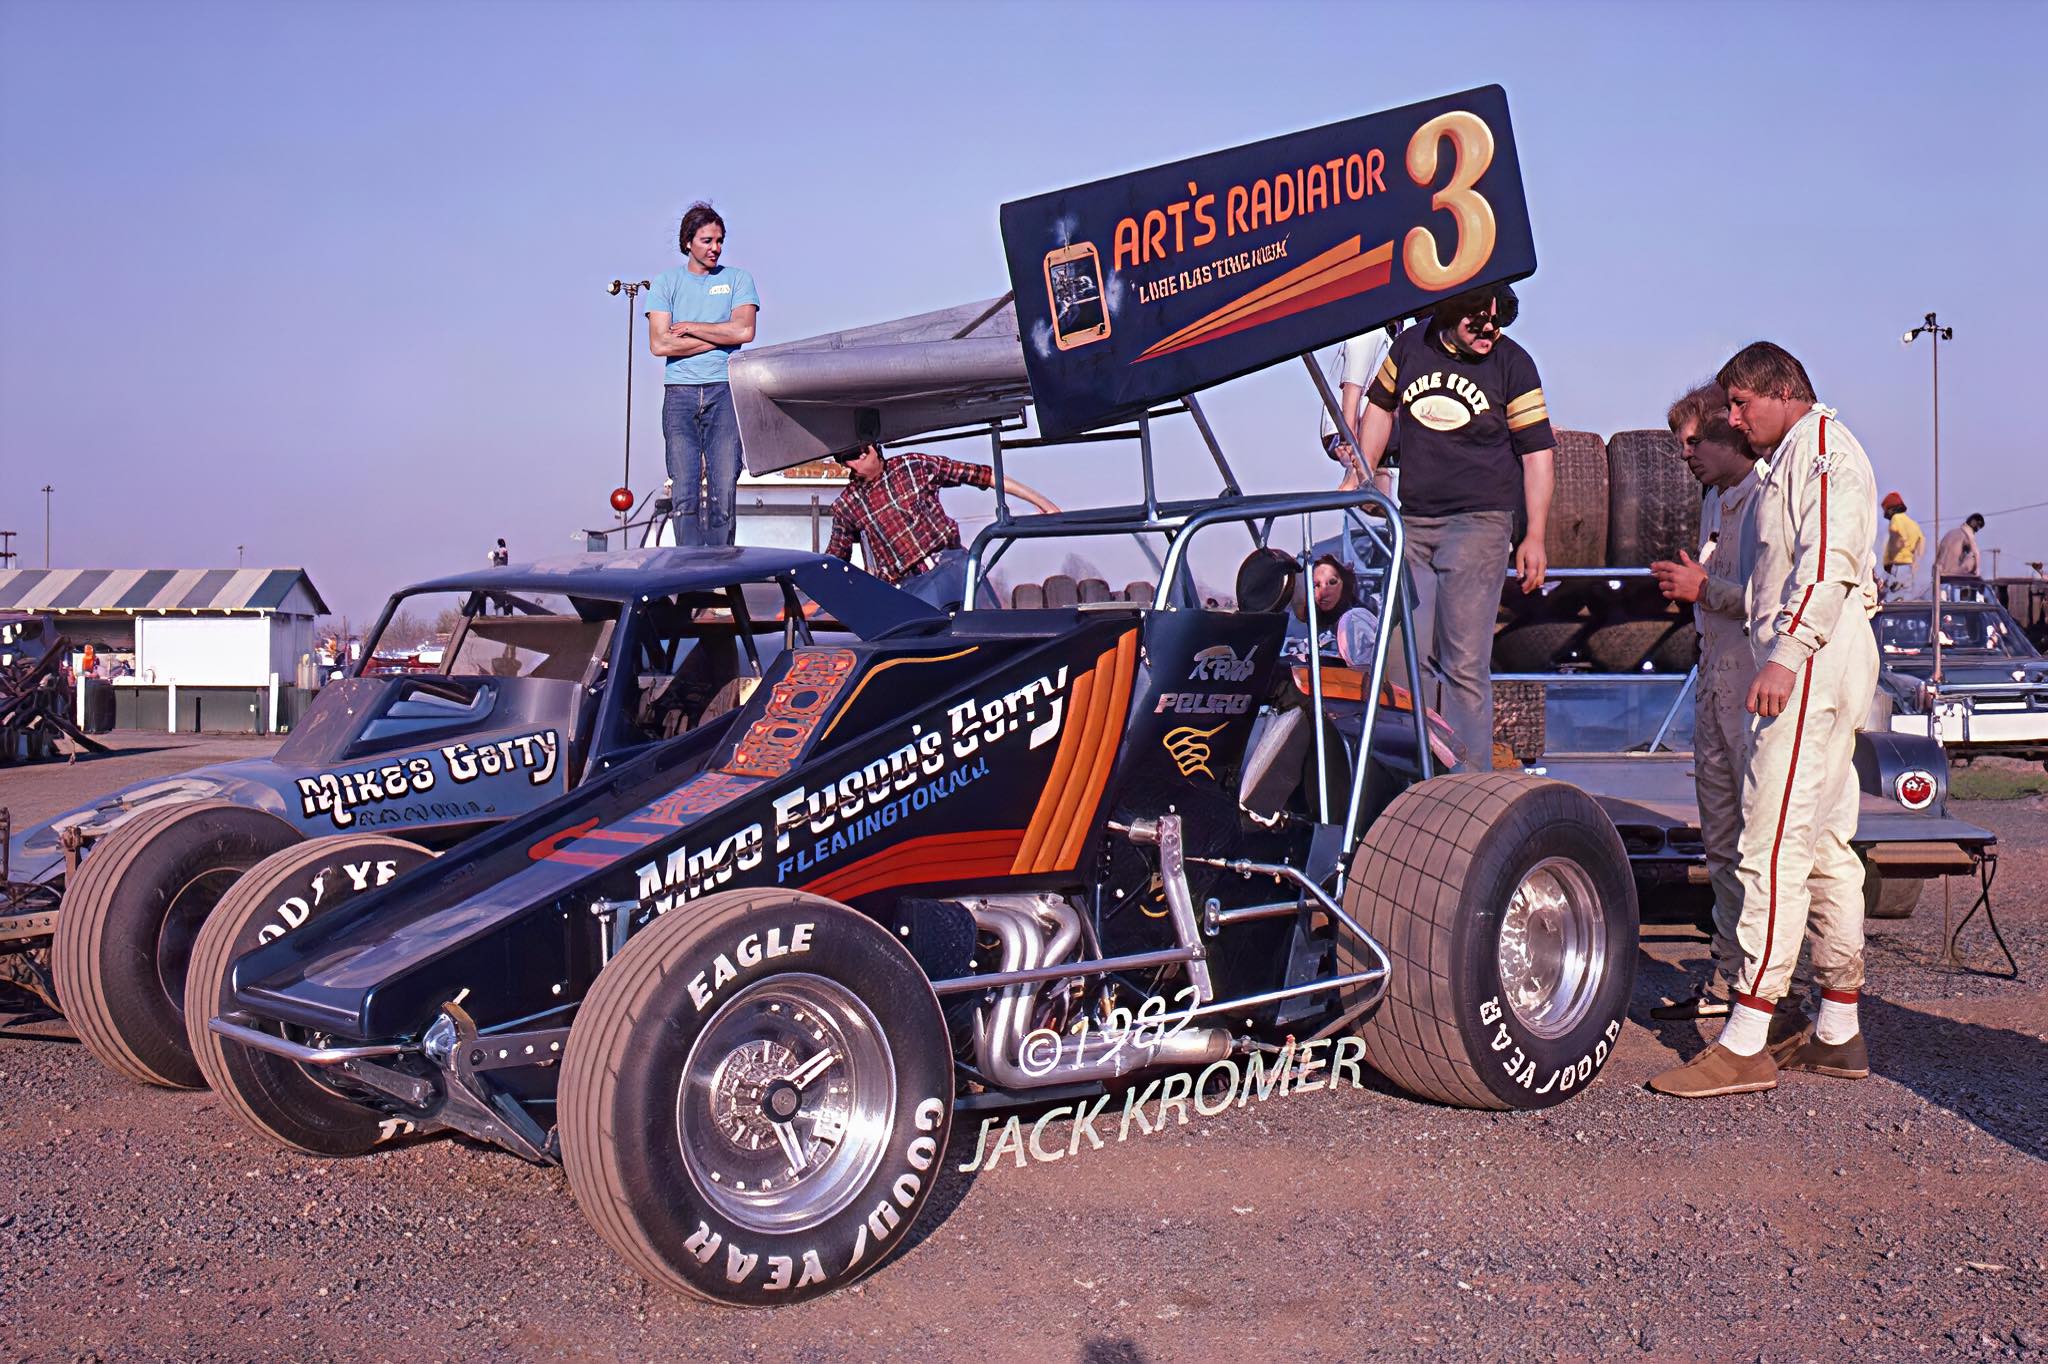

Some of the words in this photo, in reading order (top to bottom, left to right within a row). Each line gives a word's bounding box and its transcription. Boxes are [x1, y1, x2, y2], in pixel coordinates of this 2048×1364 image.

[1113, 180, 1218, 273] ART'S
[1226, 147, 1388, 238] RADIATOR
[1403, 109, 1498, 292] 3
[686, 922, 815, 1012] EAGLE
